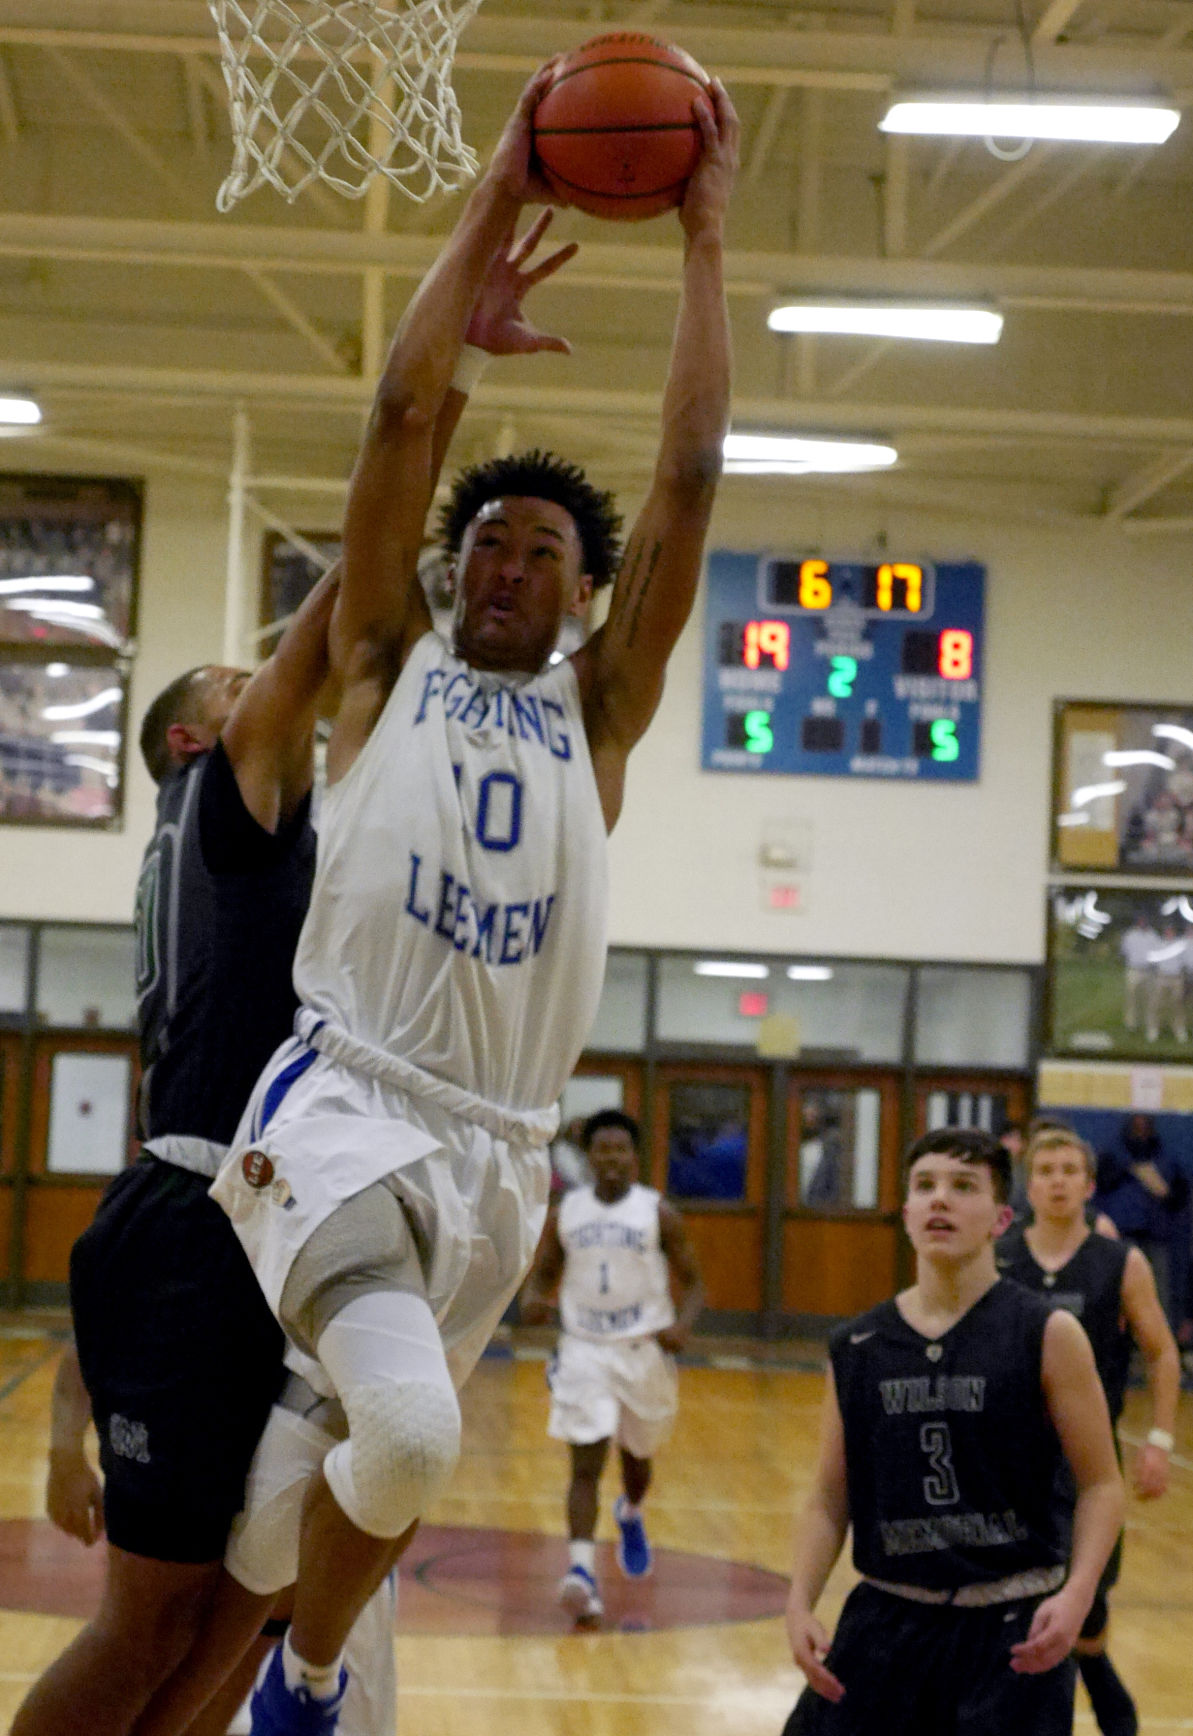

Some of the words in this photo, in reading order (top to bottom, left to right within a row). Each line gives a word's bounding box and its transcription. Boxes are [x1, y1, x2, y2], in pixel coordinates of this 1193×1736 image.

[799, 559, 832, 610] 6
[876, 562, 923, 613] 17
[743, 619, 790, 671] 19
[938, 628, 973, 681] 8
[827, 655, 857, 697] 2
[744, 710, 774, 754] 5
[930, 718, 960, 762] 5
[920, 1421, 960, 1505] 3
